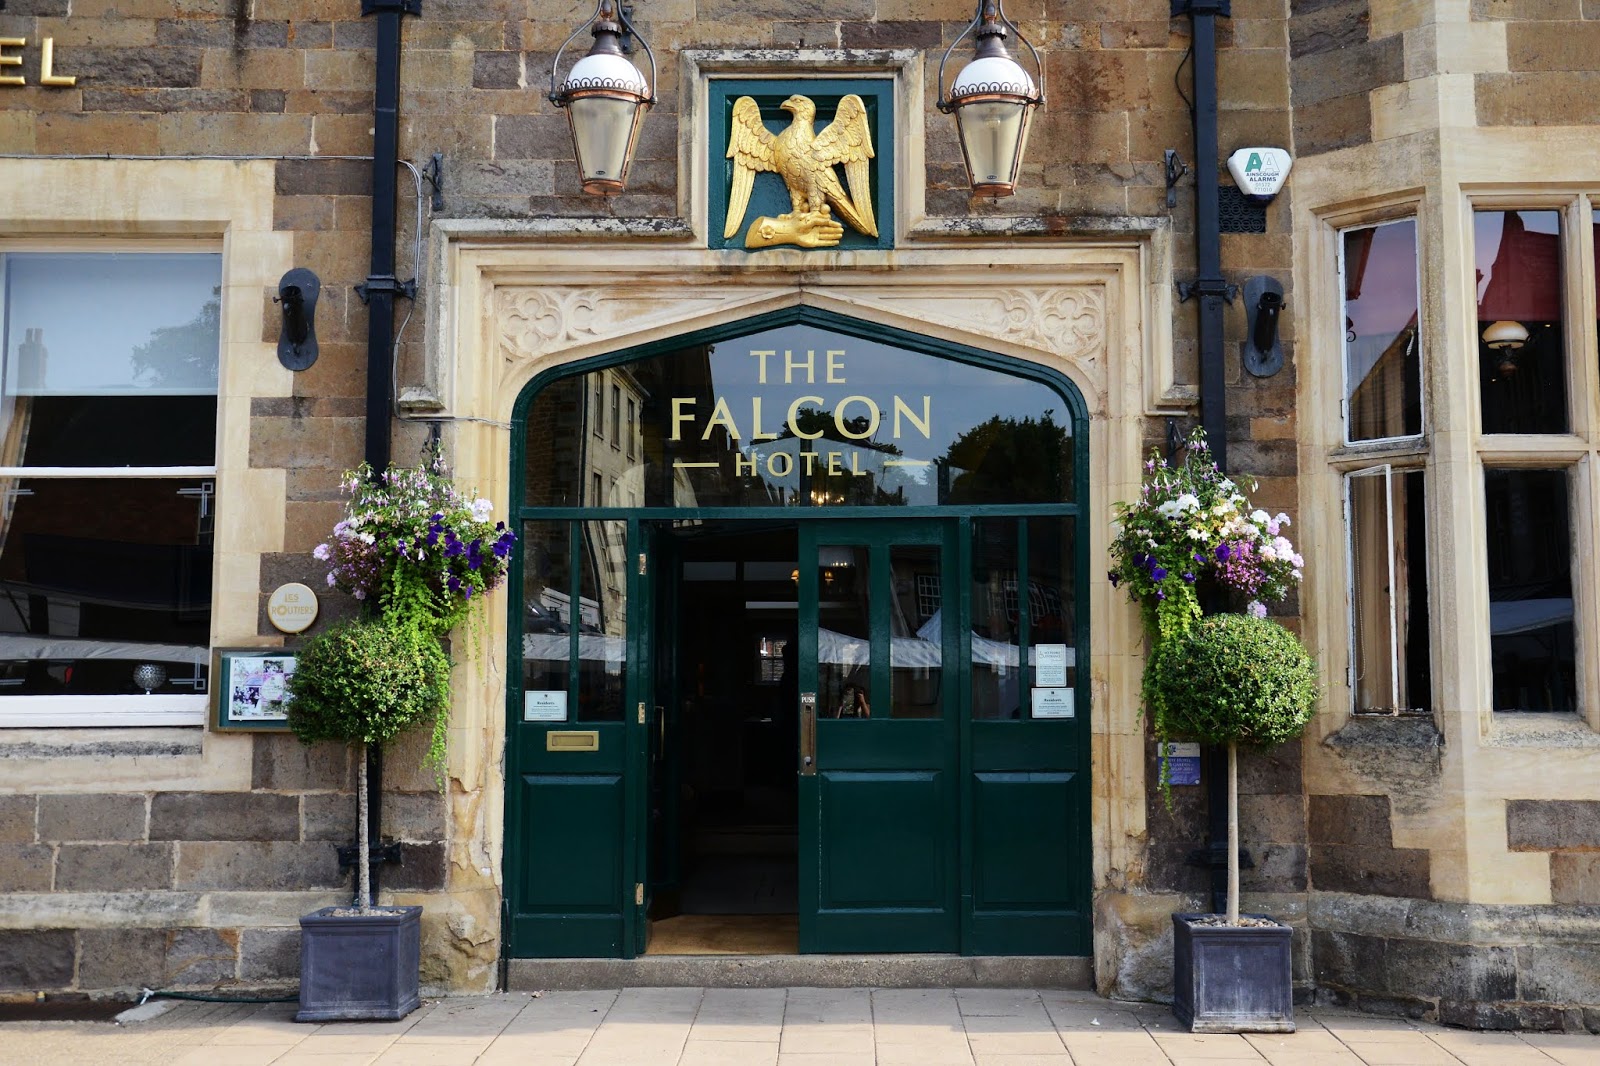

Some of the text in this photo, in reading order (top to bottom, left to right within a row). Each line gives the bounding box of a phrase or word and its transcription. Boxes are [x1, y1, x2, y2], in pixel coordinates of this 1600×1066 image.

[750, 350, 847, 384] THE
[671, 395, 931, 441] FALCON
[735, 451, 867, 477] HOTEL
[271, 605, 314, 616] ROUTIERS
[284, 593, 299, 602] LES
